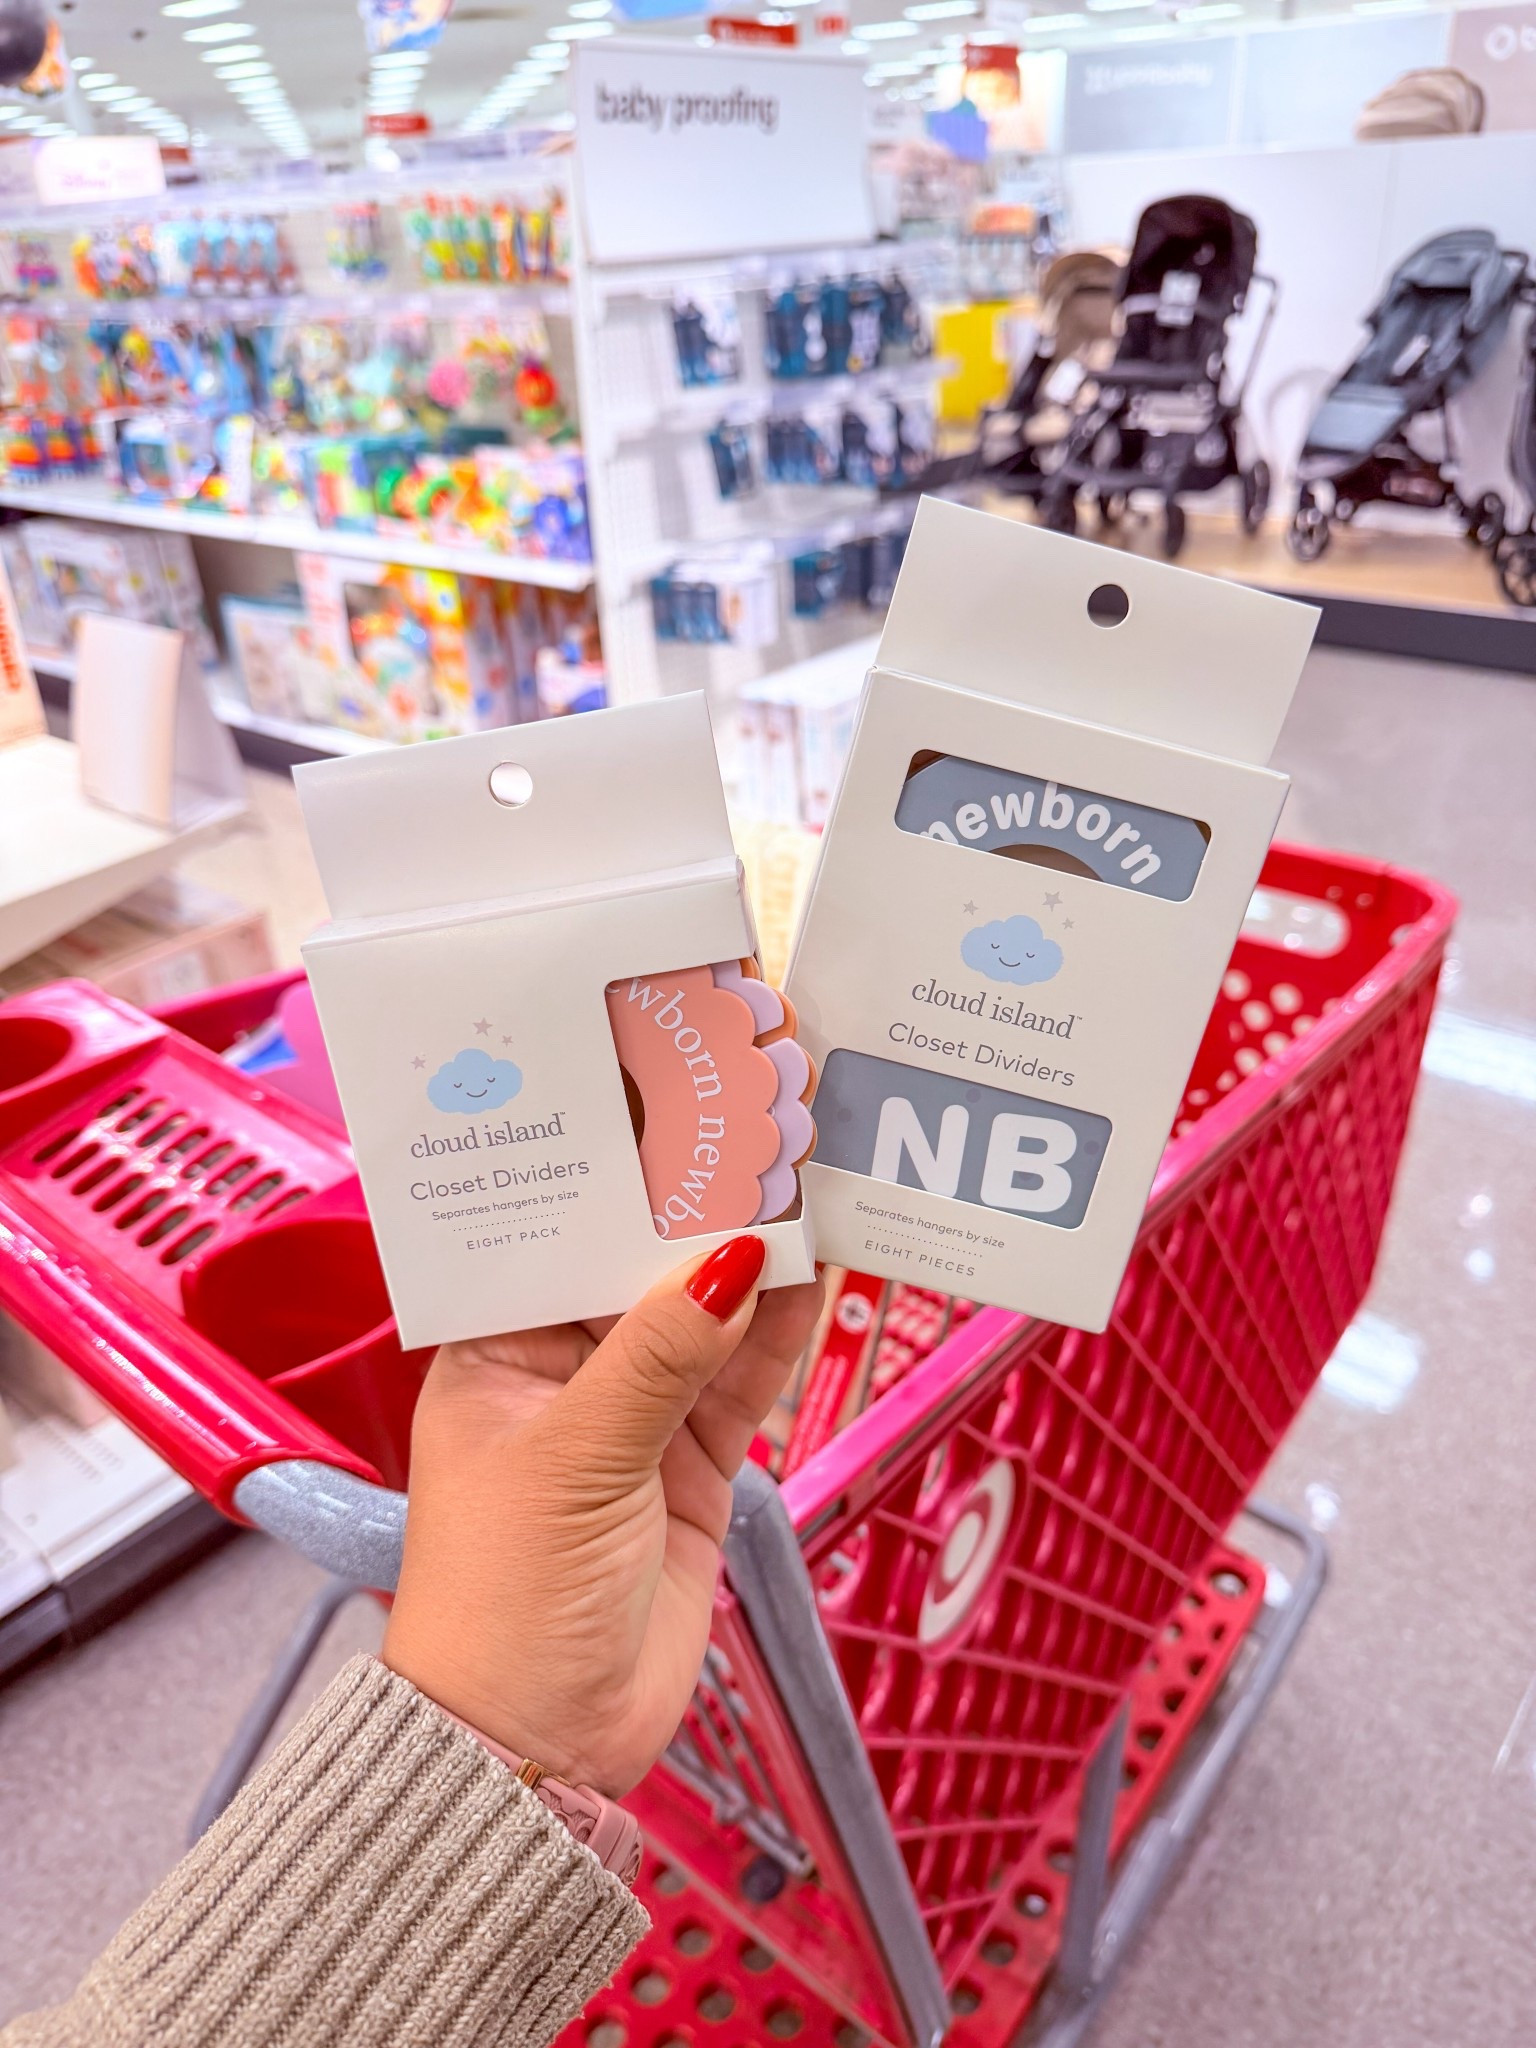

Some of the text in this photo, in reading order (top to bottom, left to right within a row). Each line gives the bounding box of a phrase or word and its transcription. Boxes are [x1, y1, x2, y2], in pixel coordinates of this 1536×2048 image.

[594, 79, 780, 136] baby proofing
[919, 780, 1161, 885] newborn
[911, 978, 987, 1017] cloud
[605, 976, 723, 1102] wborn
[888, 1022, 1075, 1087] Closet Dividers
[410, 1126, 481, 1159] cloud
[870, 1096, 1078, 1213] NB
[410, 1160, 590, 1201] Closet Dividers
[432, 1189, 579, 1221] Separates hangers by size
[854, 1200, 1006, 1249] Separates hangers by size
[466, 1226, 561, 1250] EIGHT PACK
[864, 1239, 977, 1277] EIGHT PIECES
